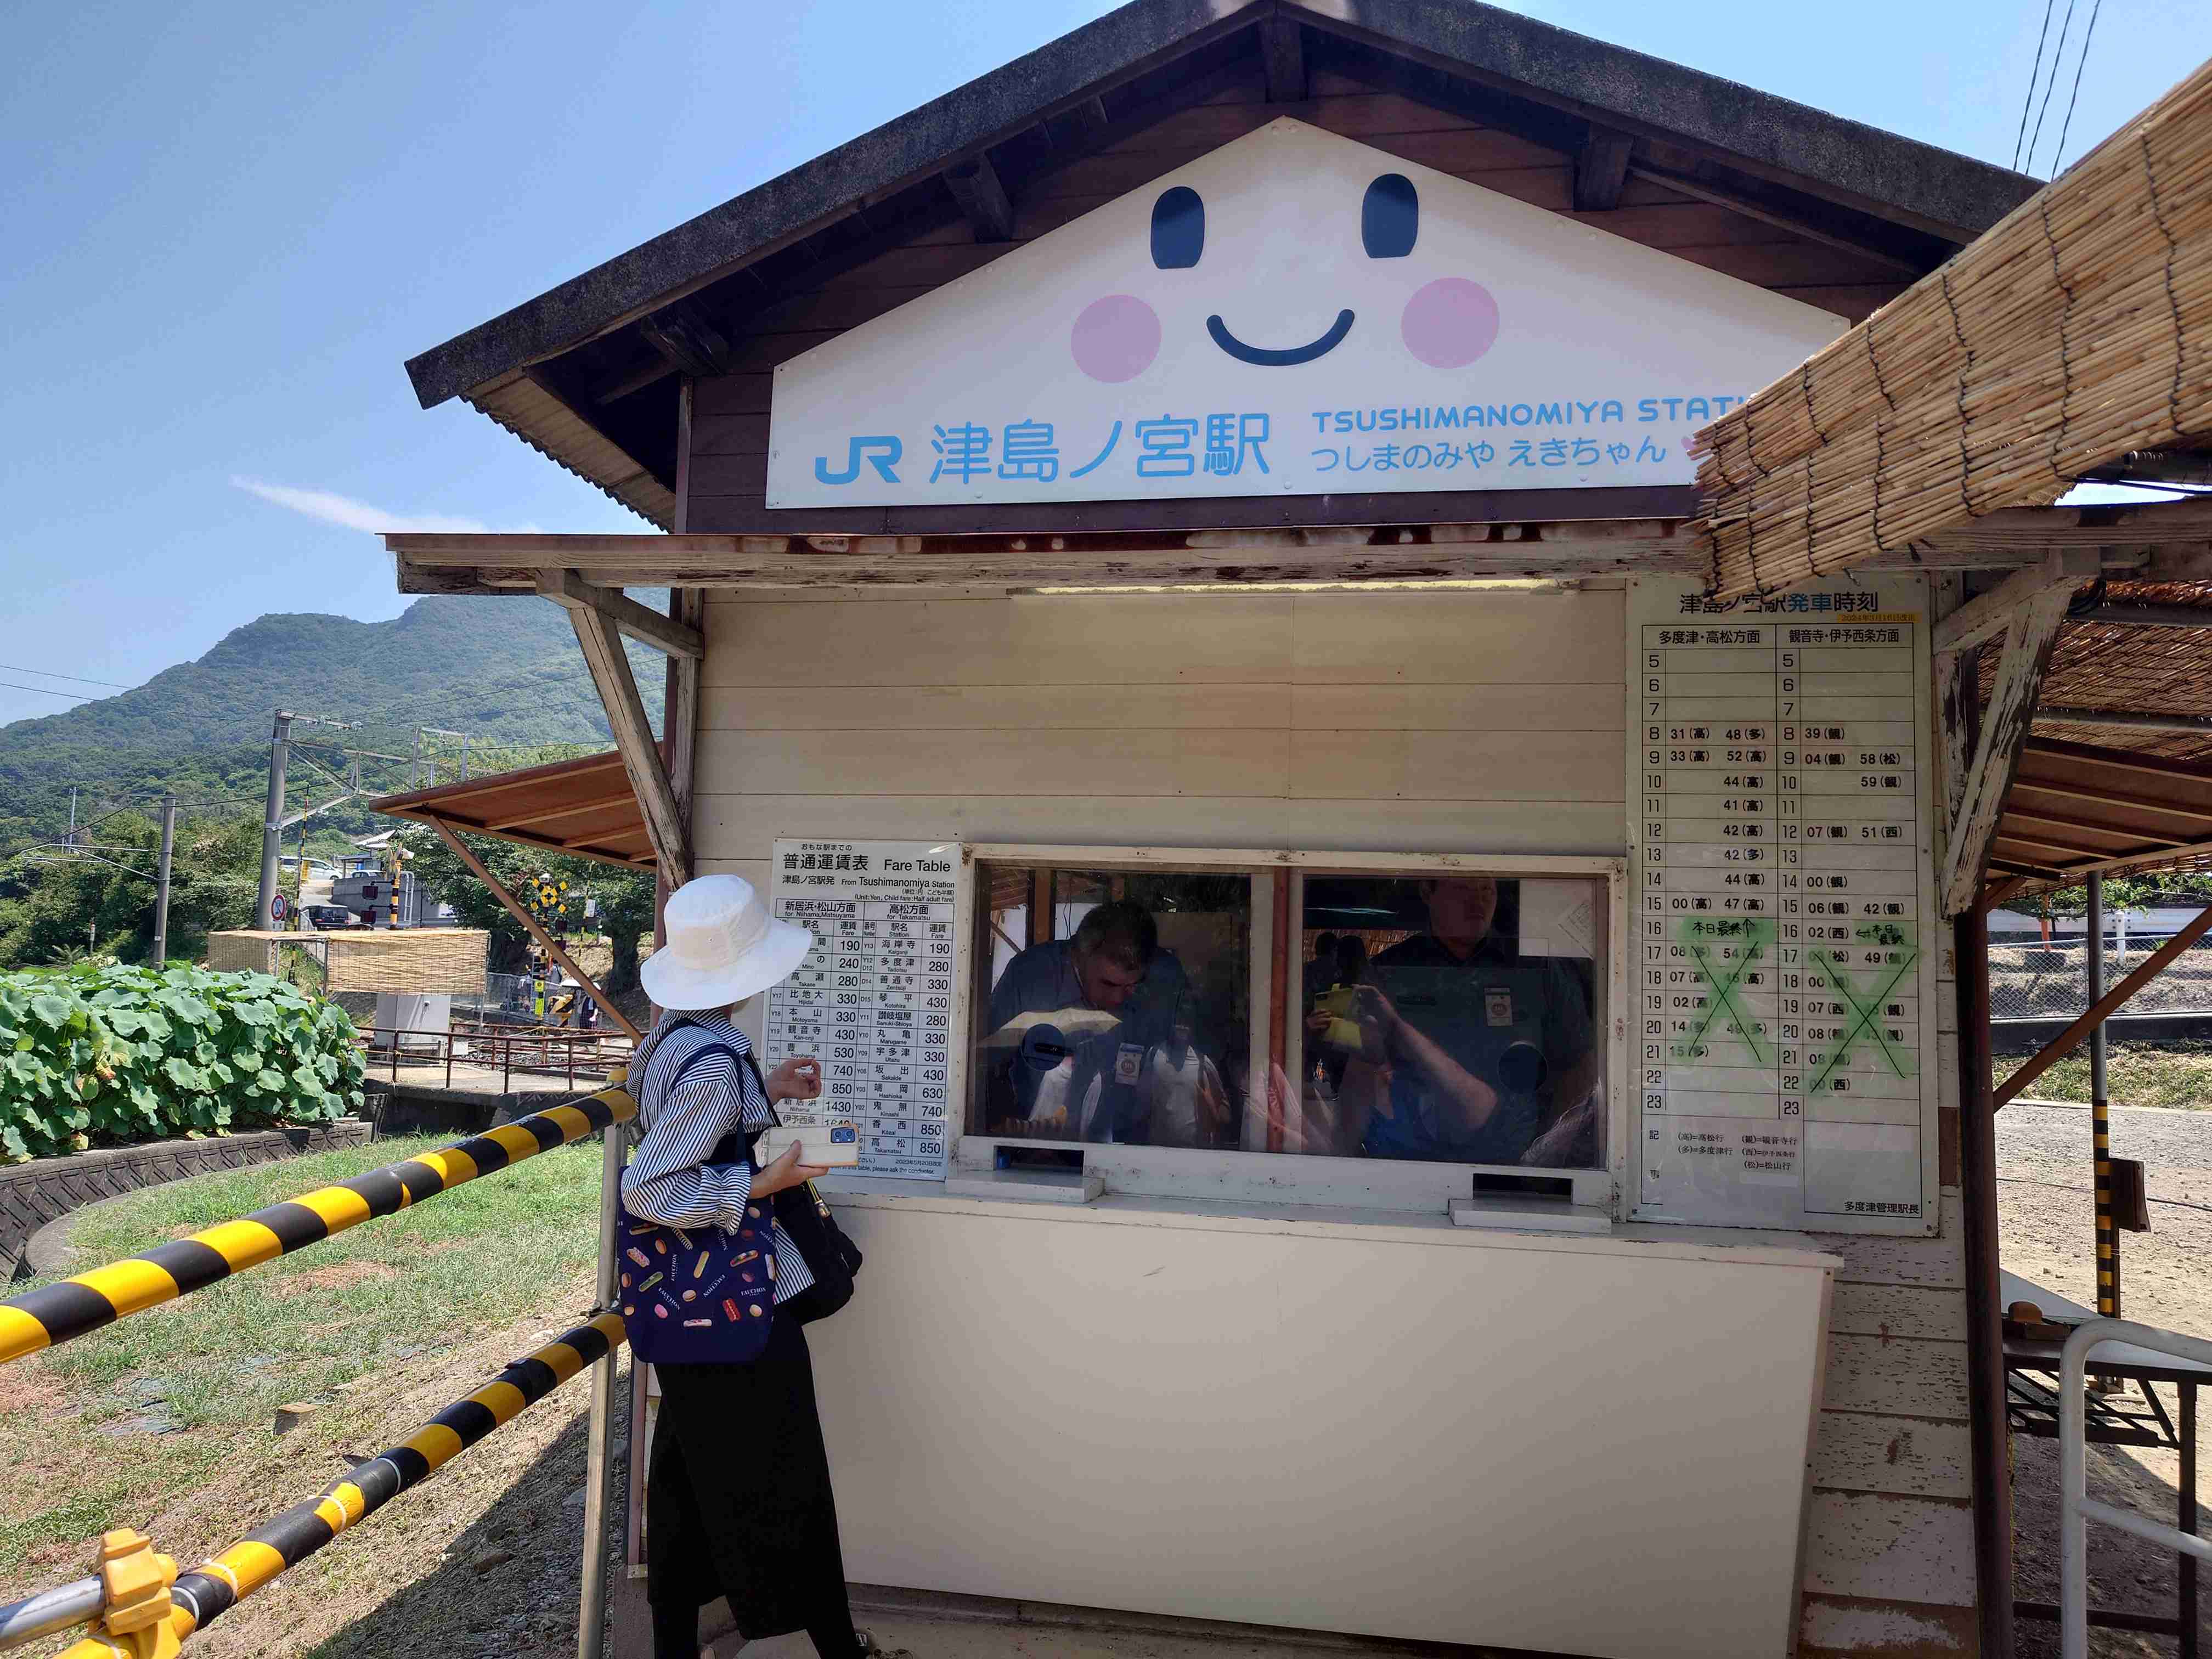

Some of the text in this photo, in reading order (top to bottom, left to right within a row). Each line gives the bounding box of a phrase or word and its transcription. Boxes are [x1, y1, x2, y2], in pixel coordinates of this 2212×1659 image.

[1312, 396, 1743, 433] TSUSHIMANOMIYA STAT
[815, 413, 1270, 485] JR 津島ノ宮駅
[1311, 436, 1667, 472] つしまのみや えきちゃん
[1658, 630, 1760, 645] 多度津・高松方面
[1789, 629, 1899, 643] 観音寺・伊予西条方面
[1649, 655, 1659, 667] 5
[1783, 654, 1793, 667] 5
[1649, 679, 1659, 691] 6
[1784, 679, 1793, 691] 6
[1650, 703, 1659, 715] 7
[1784, 703, 1793, 715] 7
[1650, 727, 1659, 740] 8
[1784, 727, 1794, 740] 8
[1650, 751, 1659, 763] 9
[1784, 752, 1794, 764] 9
[1647, 776, 1661, 787] 10
[1782, 777, 1796, 789] 10
[1647, 800, 1660, 812] 11
[1782, 800, 1795, 814] 11
[1647, 824, 1661, 836] 12
[1782, 826, 1796, 838] 12
[1647, 849, 1661, 861] 13
[1782, 850, 1796, 862] 13
[783, 854, 951, 872] 普通運賃表 Fare Table
[782, 875, 834, 885] 津島ノ宮駅発
[859, 877, 930, 889] Tsushimanomiya
[1647, 873, 1661, 885] 14
[1783, 875, 1797, 888] 14
[889, 904, 928, 915] 高松方面
[1647, 898, 1661, 910] 15
[1783, 900, 1797, 912] 15
[802, 920, 819, 929] 駅名
[840, 921, 856, 930] 運賃
[891, 923, 907, 932] 駅名
[929, 924, 946, 933] 運賃
[1647, 922, 1661, 934] 16
[1784, 925, 1797, 938] 16
[840, 941, 860, 951] 190
[929, 944, 950, 953] 190
[1647, 947, 1661, 960] 17
[1784, 950, 1797, 962] 17
[839, 958, 859, 969] 240
[929, 962, 949, 972] 280
[838, 976, 858, 986] 280
[1647, 972, 1661, 984] 18
[1784, 975, 1798, 988] 18
[928, 979, 947, 990] 330
[837, 994, 857, 1004] 330
[927, 997, 947, 1008] 430
[1647, 996, 1661, 1009] 19
[1784, 1000, 1798, 1013] 19
[836, 1012, 856, 1022] 330
[926, 1015, 946, 1026] 280
[1647, 1021, 1661, 1034] 20
[1784, 1025, 1798, 1038] 20
[835, 1030, 855, 1040] 430
[925, 1034, 945, 1044] 330
[834, 1048, 854, 1058] 530
[924, 1052, 944, 1062] 330
[1647, 1046, 1660, 1058] 21
[1784, 1051, 1798, 1064] 21
[833, 1065, 853, 1076] 740
[923, 1070, 943, 1080] 430
[1647, 1070, 1661, 1084] 22
[1784, 1076, 1799, 1089] 22
[832, 1084, 852, 1094] 850
[922, 1088, 943, 1098] 630
[826, 1102, 851, 1112] 1430
[1647, 1096, 1661, 1109] 23
[1784, 1102, 1799, 1115] 23
[922, 1106, 941, 1116] 740
[921, 1125, 941, 1135] 850
[1650, 1130, 1658, 1140] 記
[920, 1143, 940, 1153] 850
[1845, 1201, 1919, 1214] 多度津管理駅長
